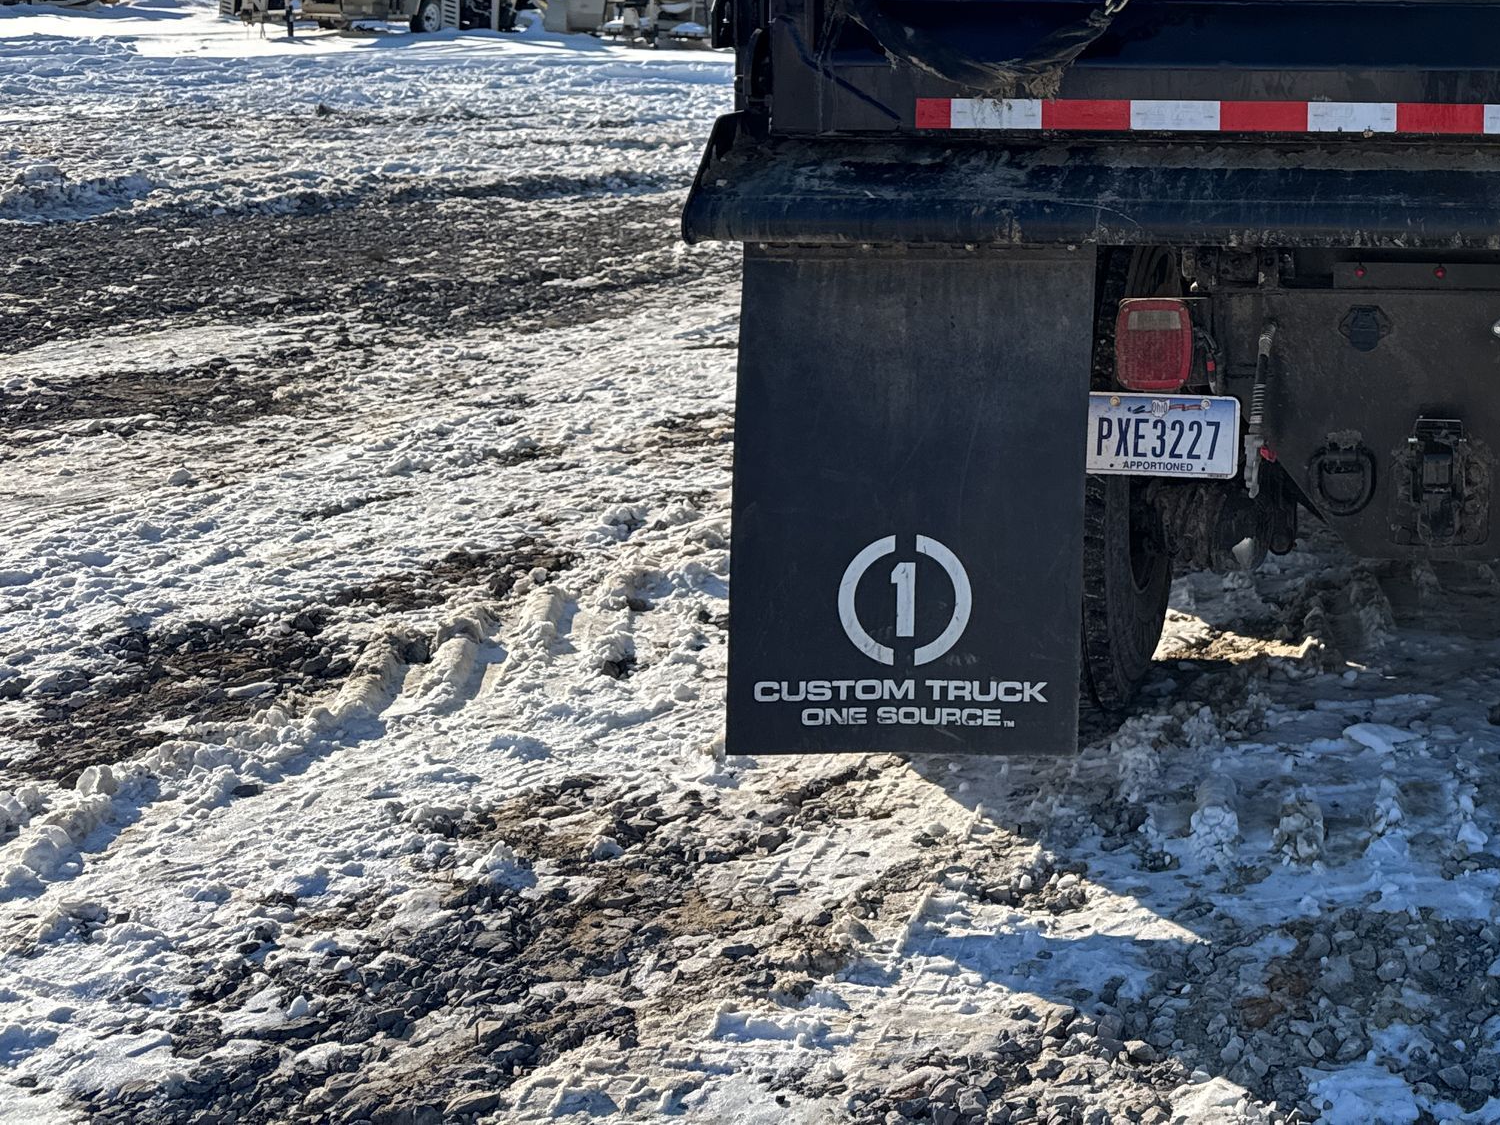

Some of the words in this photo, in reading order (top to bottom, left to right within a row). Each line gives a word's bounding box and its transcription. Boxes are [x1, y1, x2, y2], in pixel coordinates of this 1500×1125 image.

[1096, 417, 1221, 461] PXE3227
[1122, 460, 1194, 472] APPORTIONED
[890, 562, 916, 637] 1
[753, 679, 915, 702] CUSTOM
[925, 680, 1048, 703] TRUCK
[801, 707, 867, 726] ONE
[876, 707, 1002, 726] SOURCE
